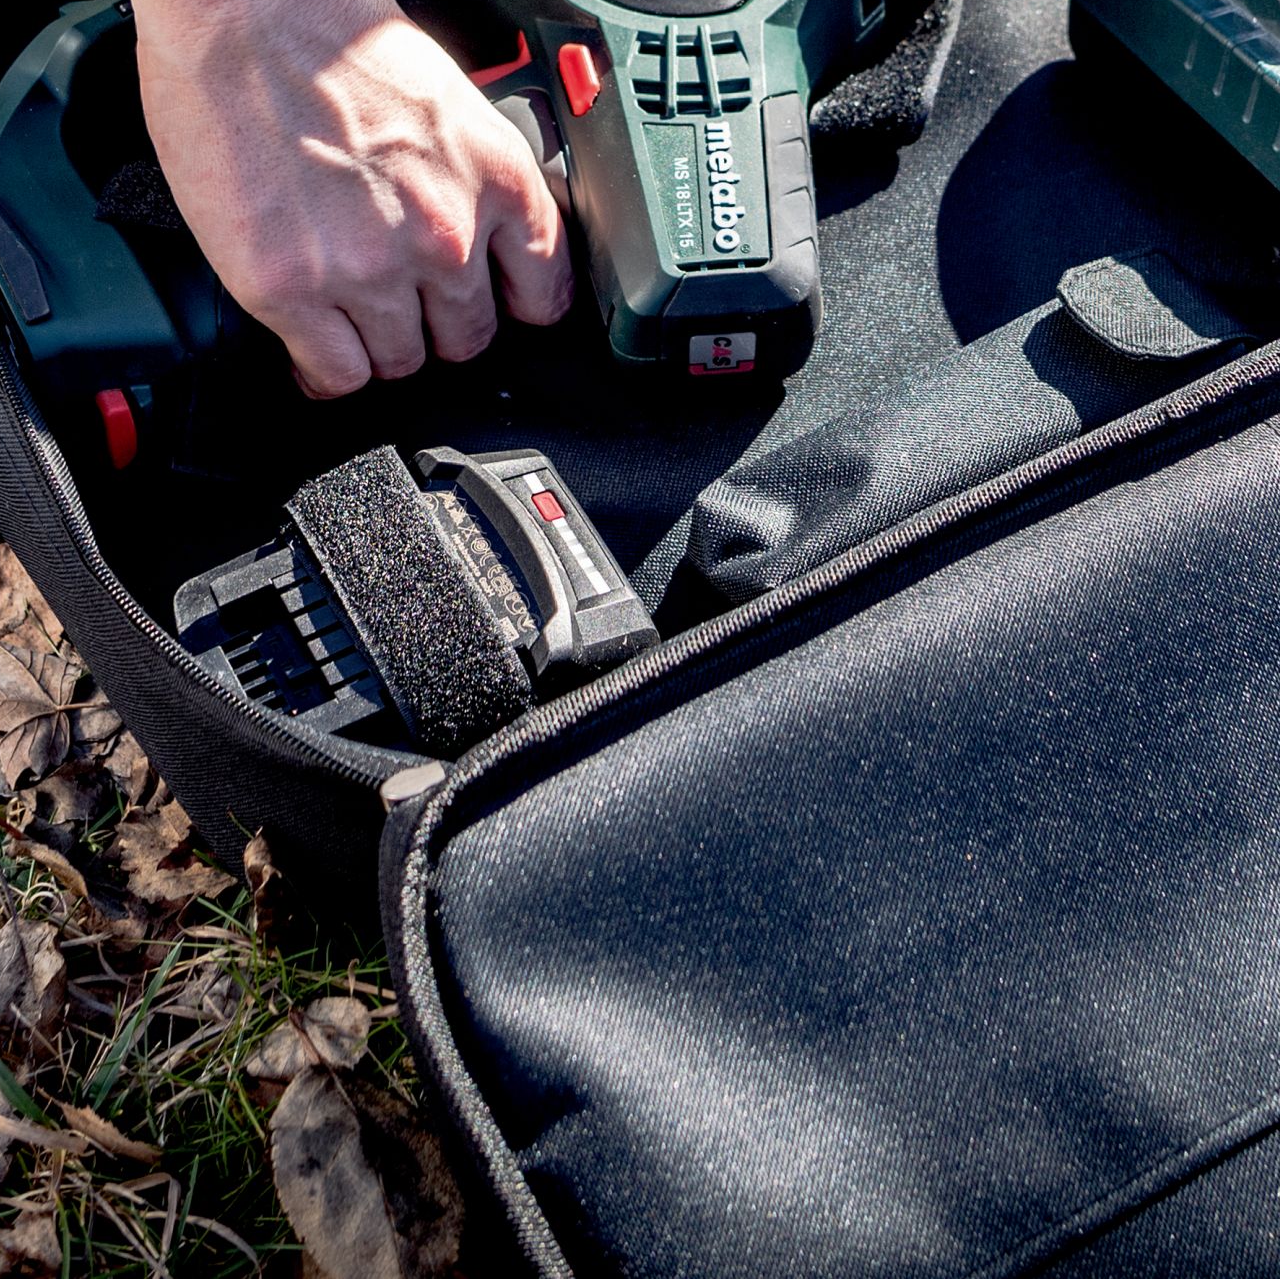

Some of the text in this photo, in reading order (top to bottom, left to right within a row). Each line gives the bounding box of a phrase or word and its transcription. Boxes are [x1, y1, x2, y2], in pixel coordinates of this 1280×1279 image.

[674, 157, 694, 248] MS 18 LTX 15
[705, 121, 746, 251] metabo
[712, 336, 733, 367] CAS
